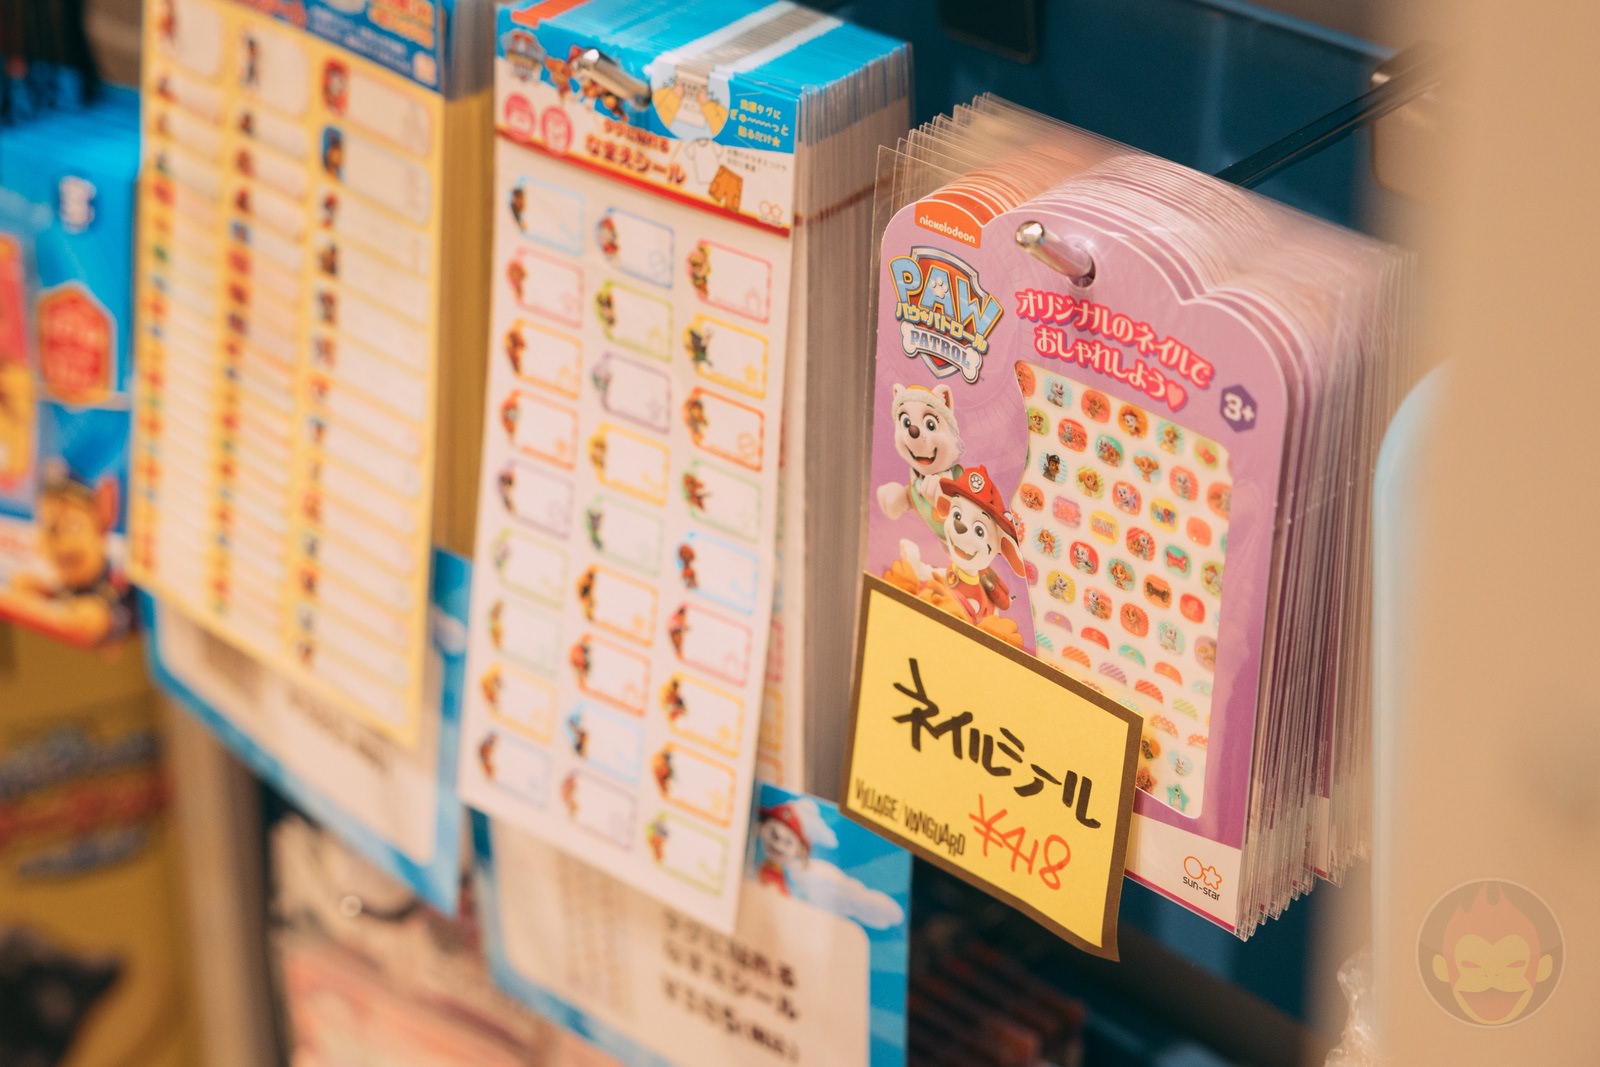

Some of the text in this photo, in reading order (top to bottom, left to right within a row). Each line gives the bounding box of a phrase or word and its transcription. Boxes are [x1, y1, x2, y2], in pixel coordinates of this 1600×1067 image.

[584, 133, 688, 186] なまえシール
[919, 215, 976, 244] nickelodeon
[888, 255, 1004, 338] PAW
[910, 330, 971, 369] PATROL
[1015, 289, 1214, 387] オリジナルのネイルで
[1224, 393, 1256, 422] 3+
[892, 658, 1102, 829] ネイルシール
[905, 805, 966, 856] VANGUARD
[968, 794, 1072, 891] ¥418
[1182, 876, 1221, 901] sun-star
